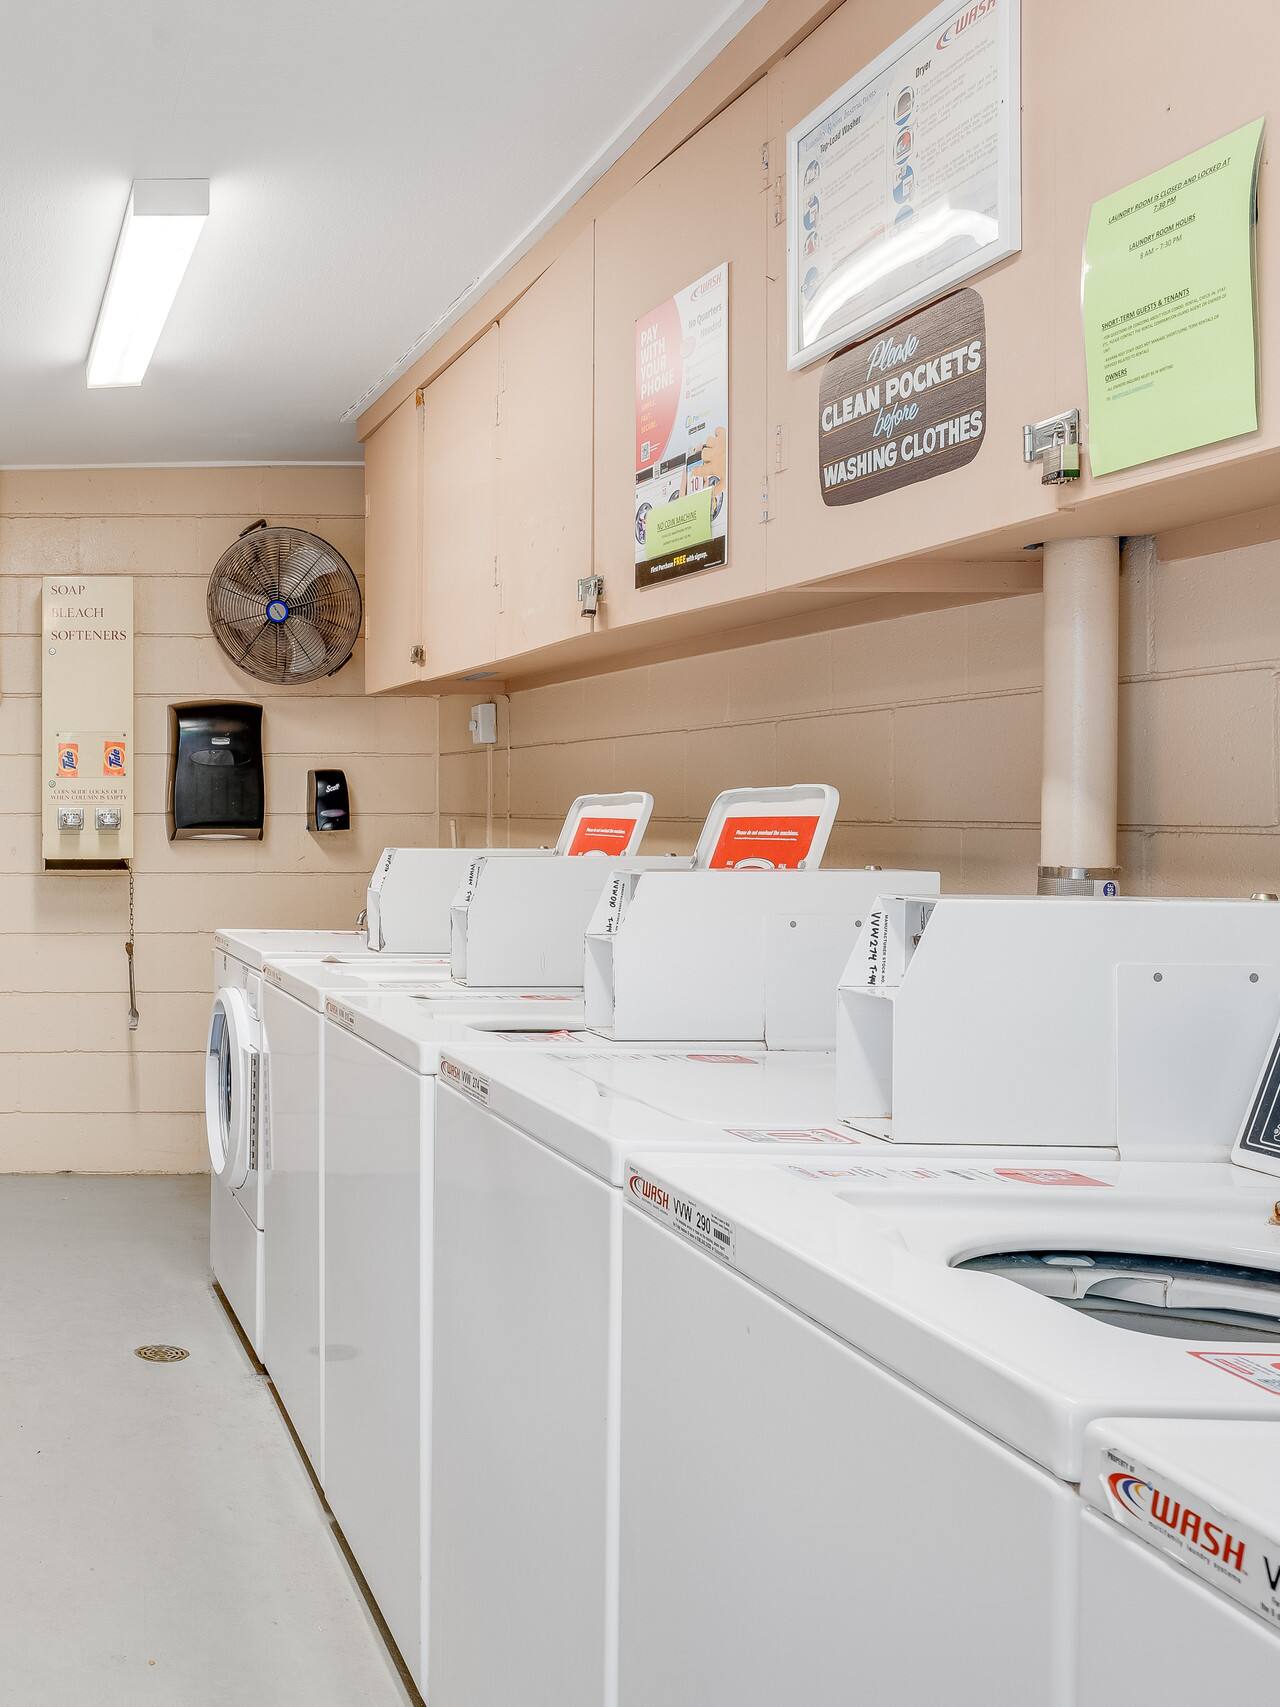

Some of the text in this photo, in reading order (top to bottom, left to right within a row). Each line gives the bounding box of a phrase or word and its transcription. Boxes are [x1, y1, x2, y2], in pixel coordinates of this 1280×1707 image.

[916, 60, 932, 78] Dryer
[842, 115, 862, 136] Washer
[1108, 206, 1134, 225] LAUNDRY
[1134, 196, 1153, 210] ROOM
[1160, 182, 1182, 198] CLOSED
[1183, 174, 1197, 186] AND
[1197, 162, 1222, 179] LOCKED
[1222, 157, 1231, 167] AT
[1153, 195, 1177, 213] 7:30 PM
[1128, 213, 1196, 252] LAUNDRY ROOM HOURS
[1144, 247, 1154, 257] AM
[1172, 234, 1183, 243] PM
[1101, 311, 1135, 331] SHORT-TERM
[1135, 301, 1157, 316] GUESTS
[1163, 287, 1190, 304] TENANTS
[641, 323, 658, 347] PAY
[641, 336, 665, 364] WITH
[866, 334, 920, 382] Please
[641, 355, 666, 381] YOUR
[1104, 367, 1128, 383] OWNERS
[641, 368, 674, 400] PHONE
[822, 340, 982, 432] CLEAN POCKETS
[872, 402, 920, 439] before
[823, 410, 983, 488] WASHING CLOTHES
[674, 554, 687, 567] FREE
[51, 585, 86, 595] SOAP
[52, 607, 104, 618] BLEACH
[50, 630, 127, 641] SOFTENERS
[62, 750, 78, 770] Tide
[108, 748, 124, 768] Tide
[867, 911, 882, 961] VVW274
[642, 1181, 670, 1210] WASH
[673, 1198, 693, 1223] VVW
[696, 1212, 711, 1235] 290
[1151, 1488, 1246, 1572] WASH
